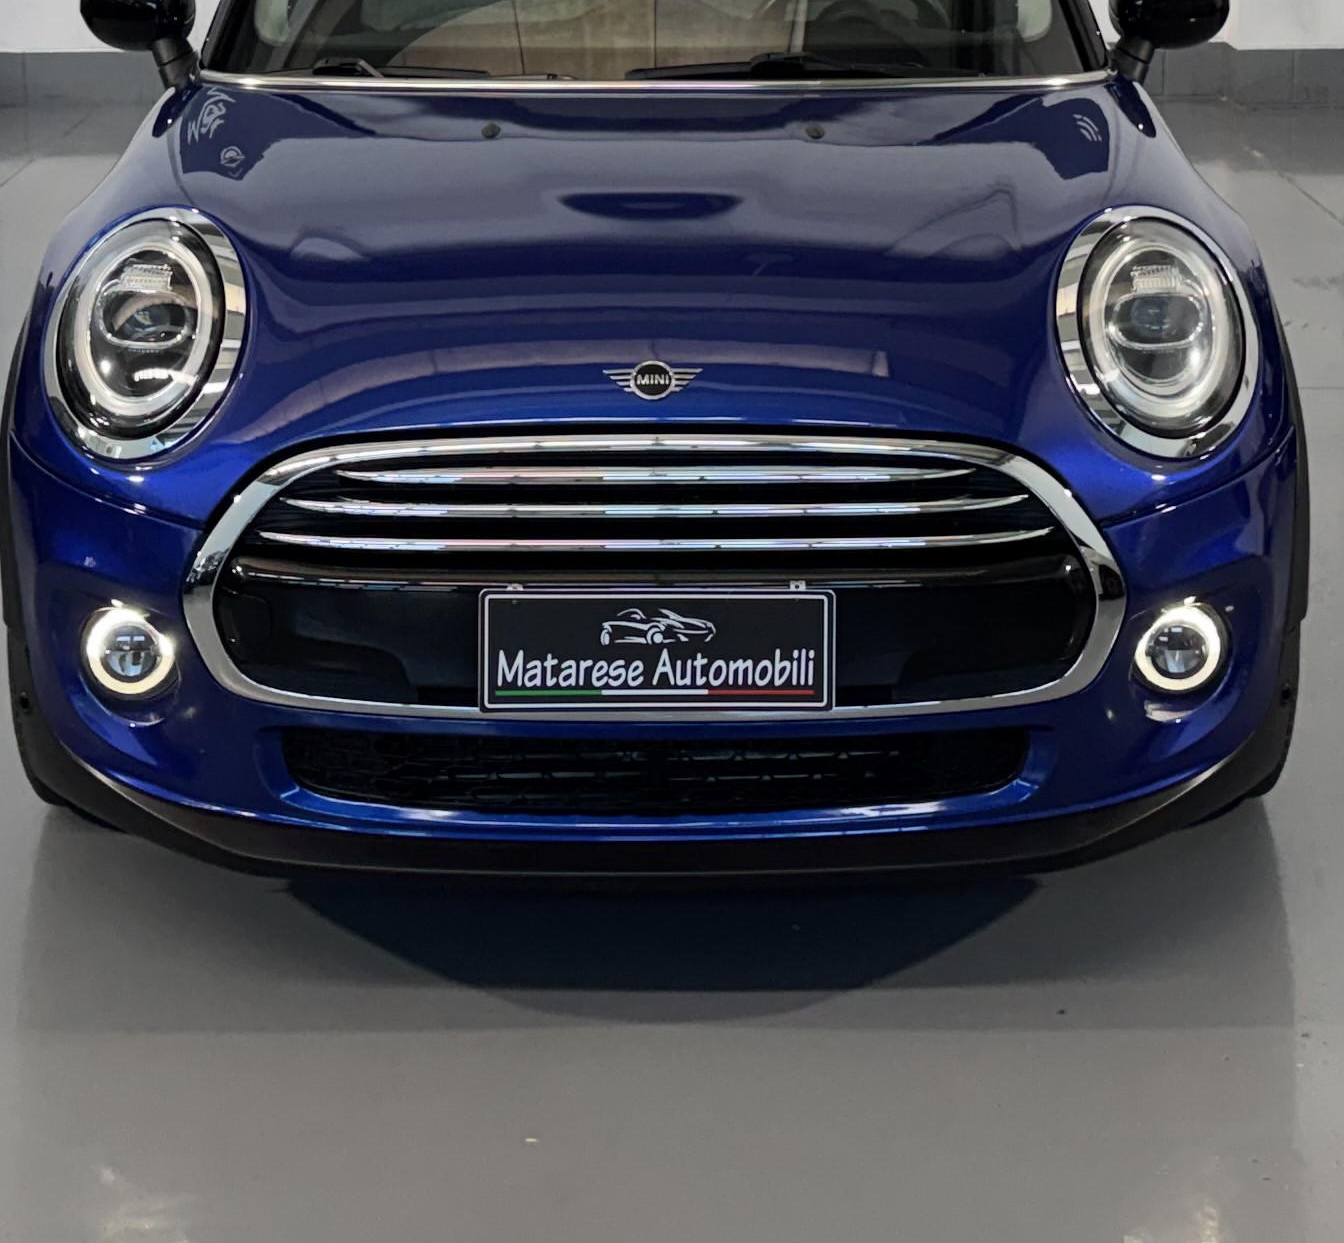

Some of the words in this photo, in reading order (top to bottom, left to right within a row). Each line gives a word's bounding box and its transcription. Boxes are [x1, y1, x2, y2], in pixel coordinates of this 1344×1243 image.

[636, 374, 670, 385] MINI
[496, 649, 644, 688] Matarese
[652, 648, 815, 688] Automobili
